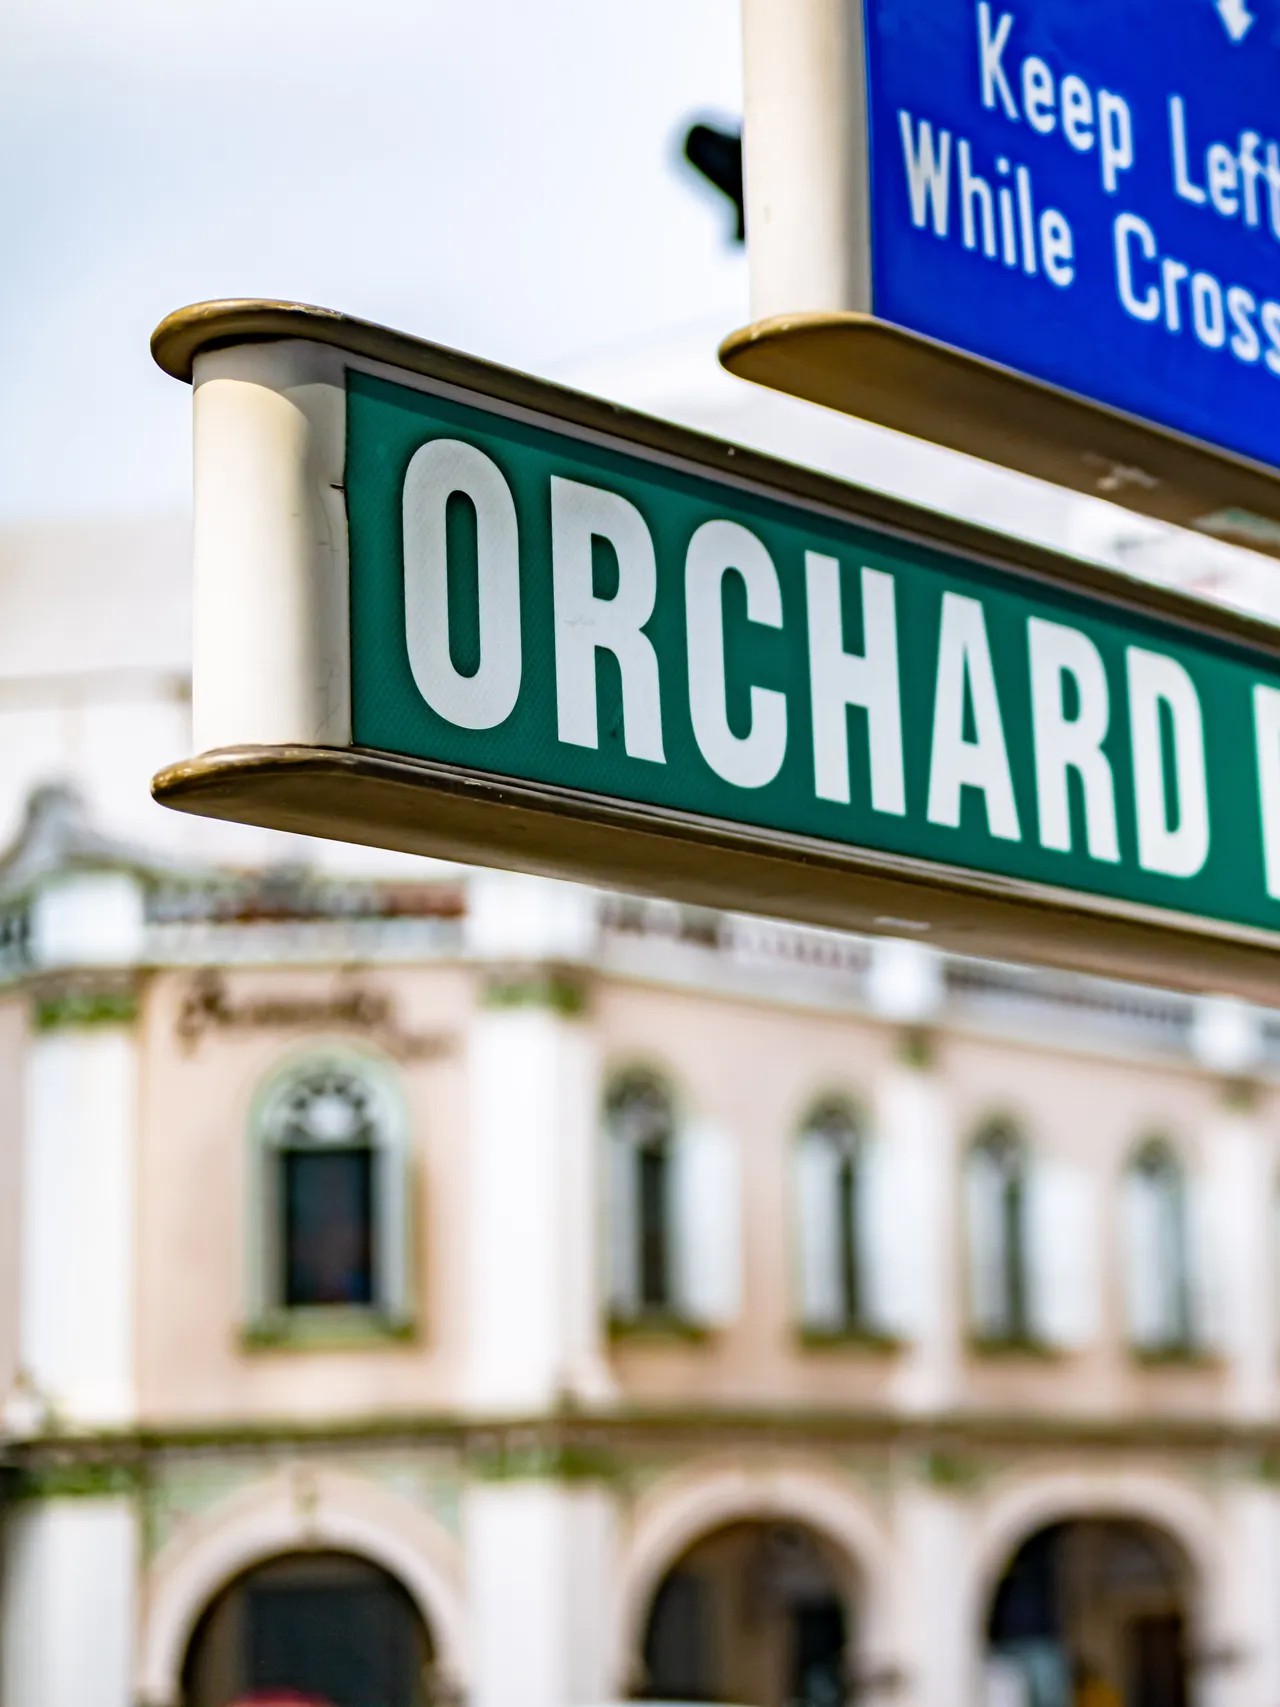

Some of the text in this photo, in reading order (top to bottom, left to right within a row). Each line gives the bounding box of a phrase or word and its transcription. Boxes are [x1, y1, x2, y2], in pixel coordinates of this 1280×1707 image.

[977, 1, 1134, 193] Keep
[899, 109, 1075, 287] While
[402, 438, 1210, 879] ORCHARD
